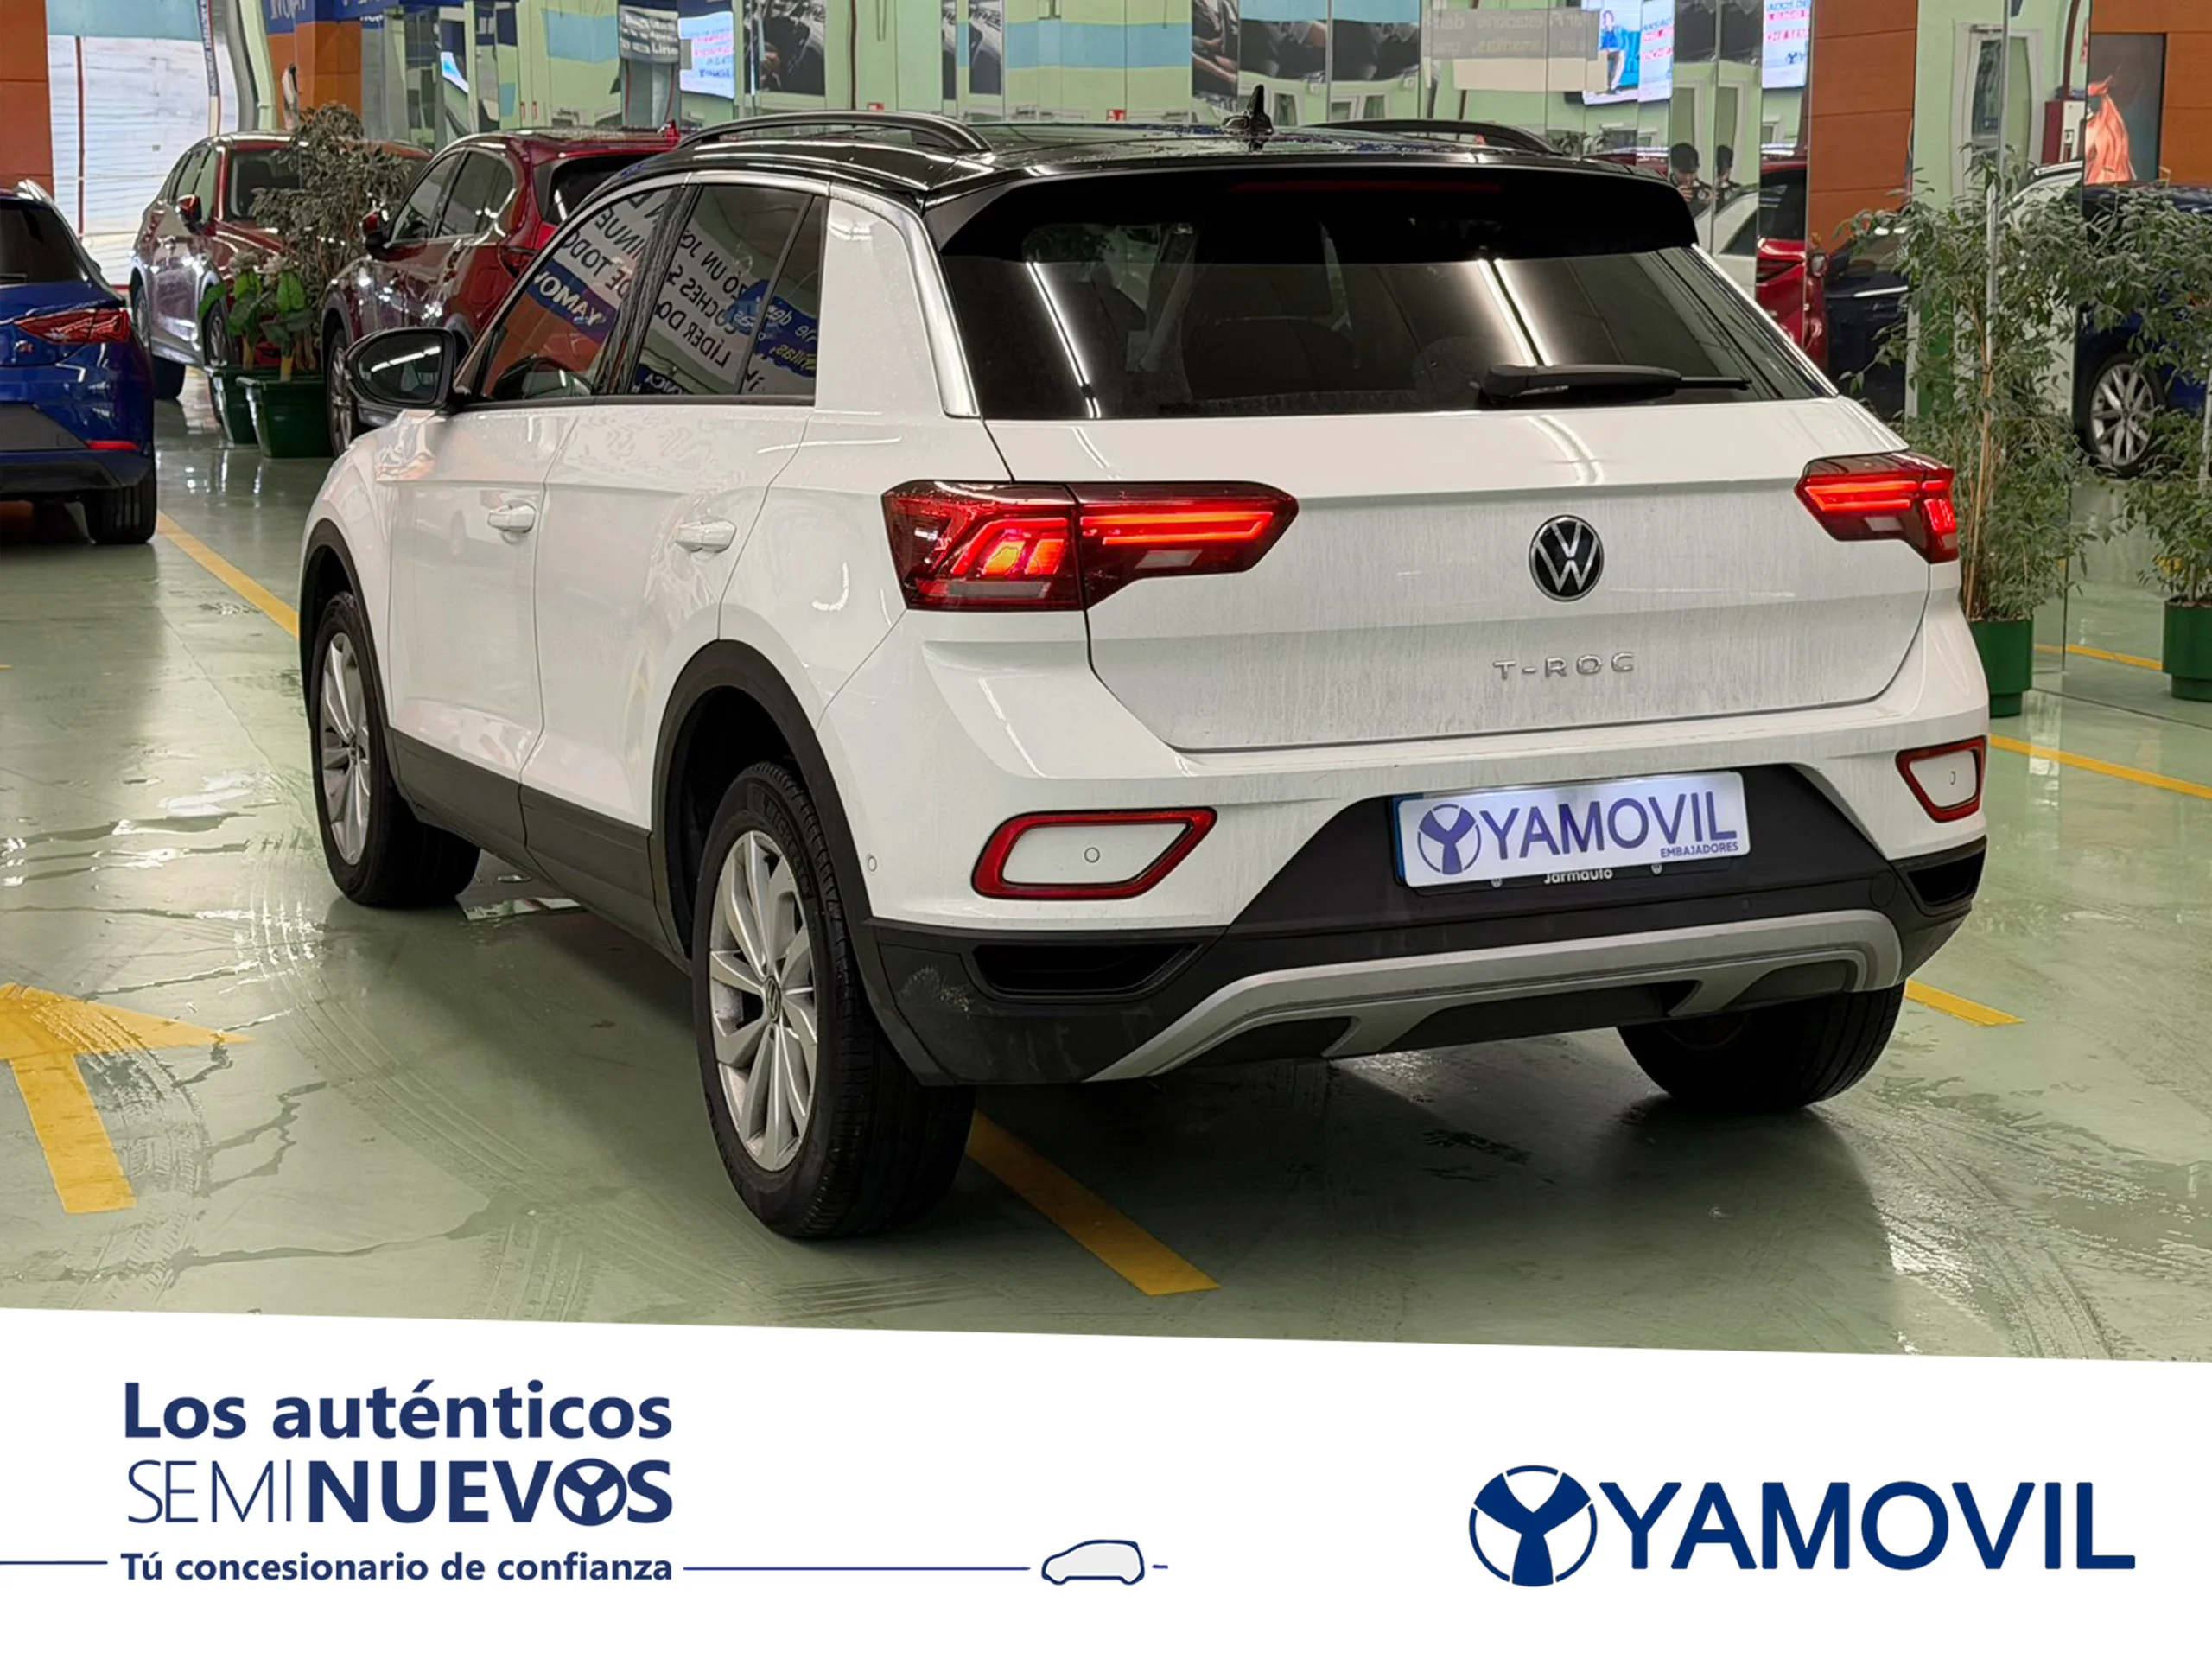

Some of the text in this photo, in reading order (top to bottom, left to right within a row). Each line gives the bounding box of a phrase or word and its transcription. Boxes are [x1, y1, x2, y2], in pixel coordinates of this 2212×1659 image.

[1492, 652, 1634, 680] T-ROC
[1480, 791, 1738, 860] YAMOVIL
[1660, 842, 1738, 859] EMBAJADORES
